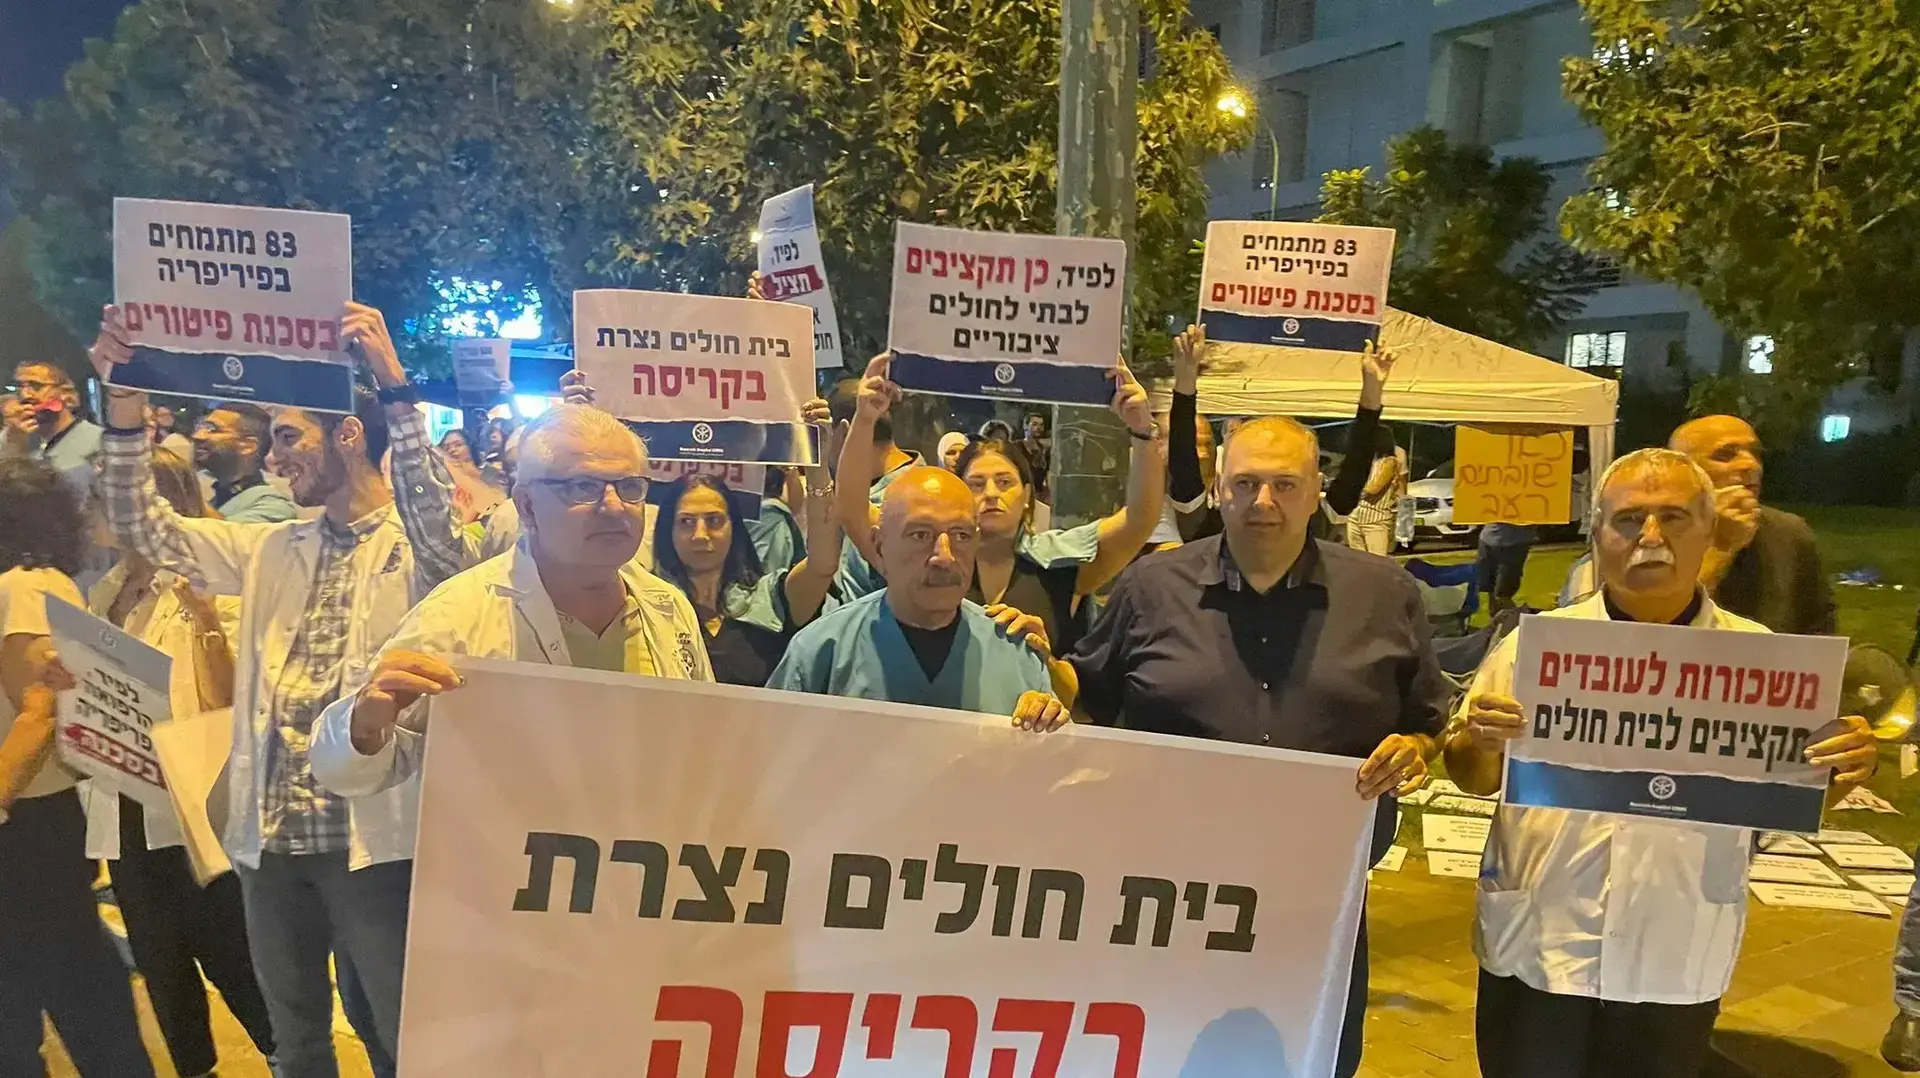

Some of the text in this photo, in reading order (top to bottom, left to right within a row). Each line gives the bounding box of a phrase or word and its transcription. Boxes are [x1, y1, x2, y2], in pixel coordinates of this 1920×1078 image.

[148, 221, 298, 259] 83 מתמחים
[1242, 234, 1357, 256] 83 מתמחים
[157, 257, 292, 292] בפיריפריה
[905, 246, 1116, 293] לפיד, כן תקציבים
[1246, 255, 1349, 278] בפיריפריה
[771, 271, 813, 297] תציל
[1211, 282, 1376, 316] בסכנת פיטורים
[929, 291, 1089, 325] לבתי לחולים
[123, 301, 339, 351] בסכנת פיטורים
[596, 326, 791, 358] בית חולים נצרת
[953, 327, 1060, 356] ציבוריים
[632, 363, 767, 410] בקריסה
[1456, 462, 1557, 488] שובתים
[1481, 493, 1549, 519] רעב
[1538, 651, 1821, 711] משכורות לעובדים
[1532, 698, 1812, 773] תקציבים לבית חולים
[512, 831, 1259, 953] בית חולים נצרת
